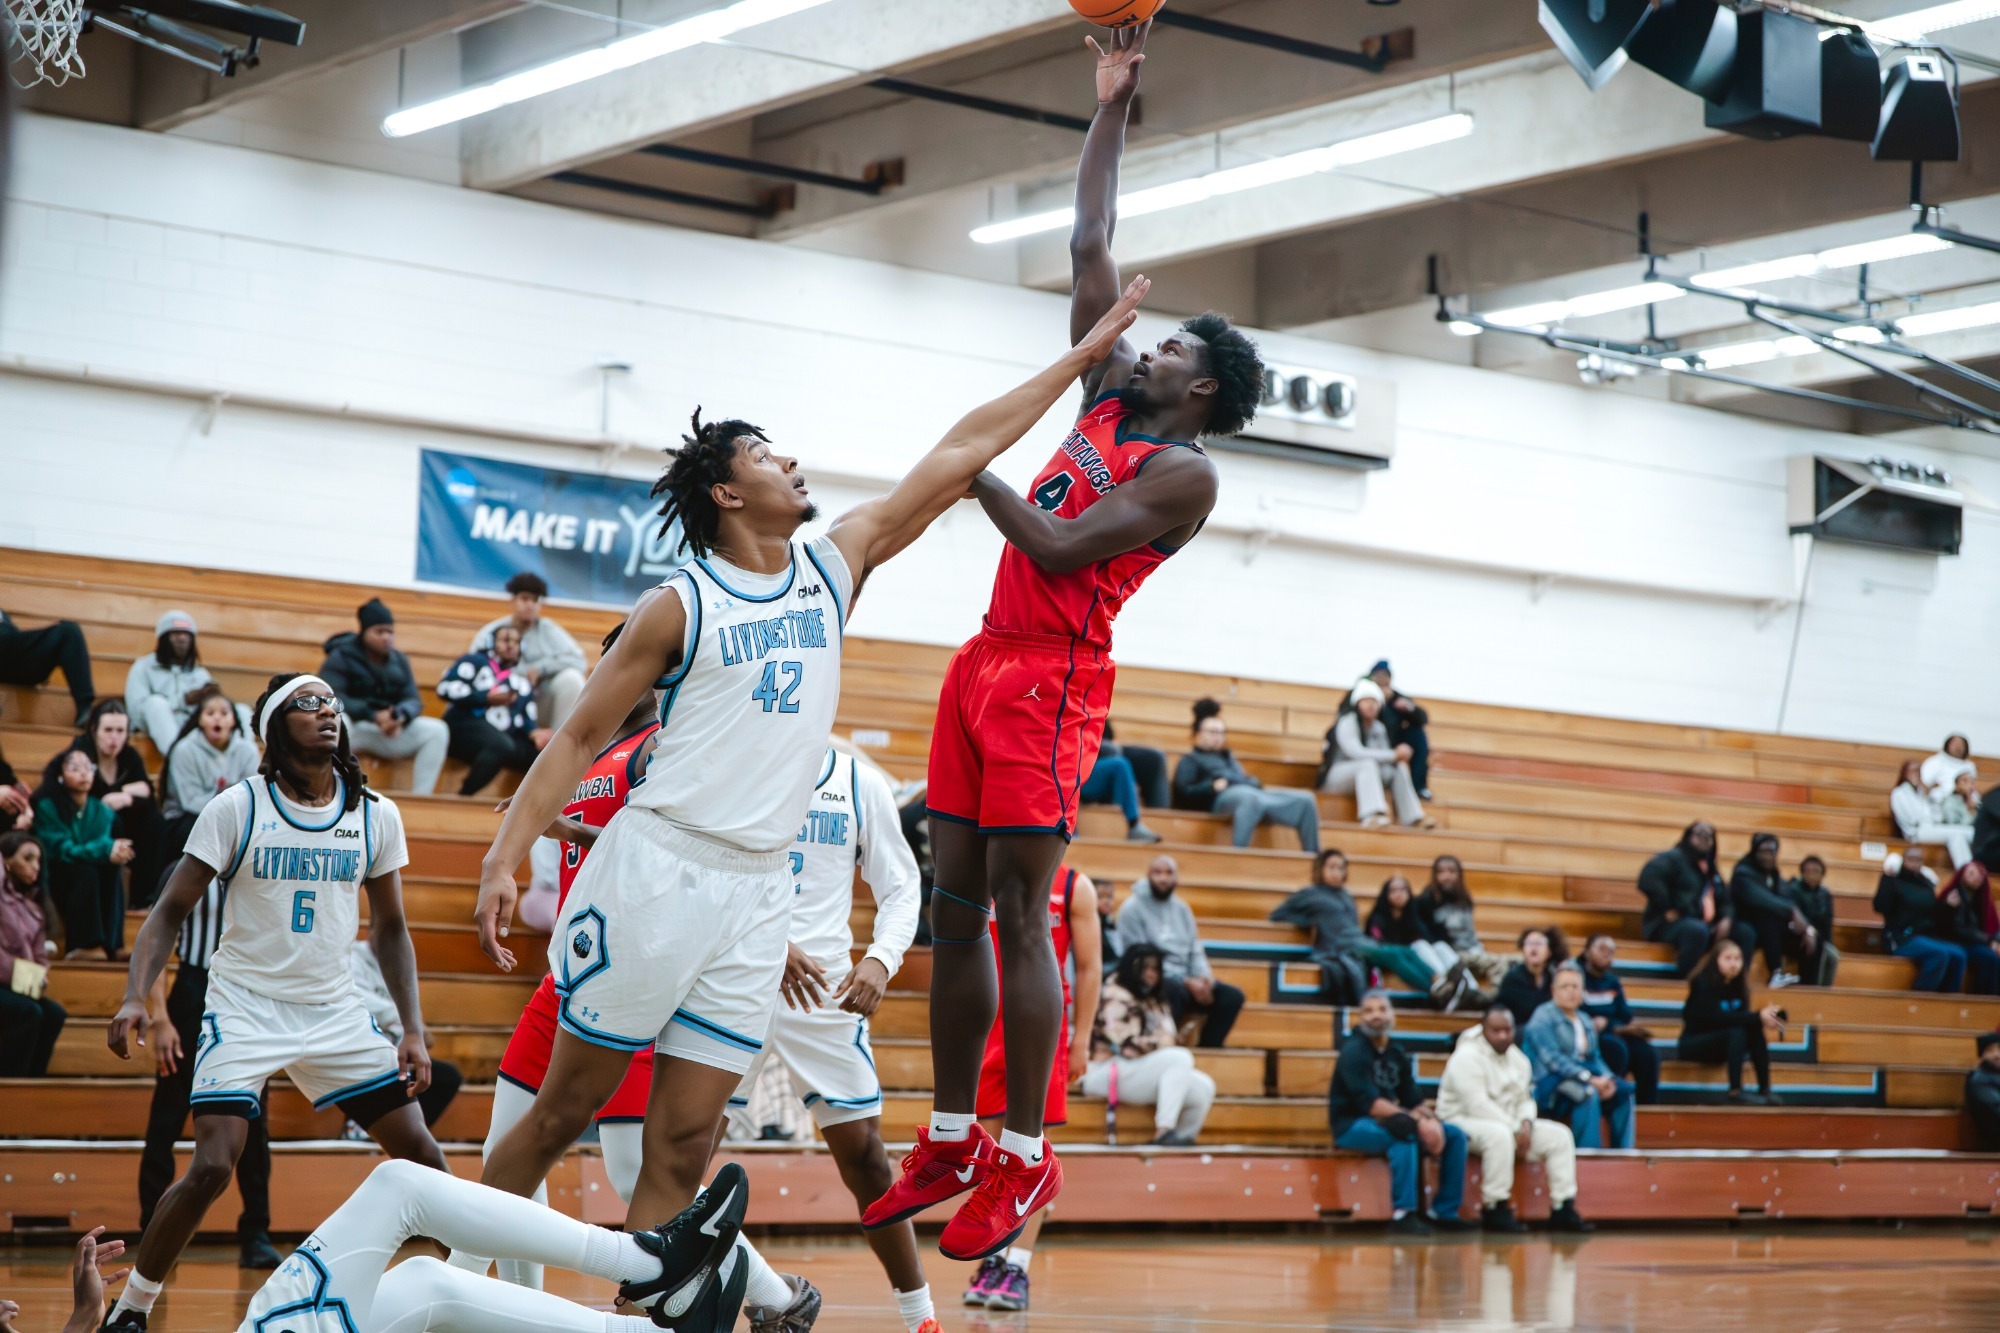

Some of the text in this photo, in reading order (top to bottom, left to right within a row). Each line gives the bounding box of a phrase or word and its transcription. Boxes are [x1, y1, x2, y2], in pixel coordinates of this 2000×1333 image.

[1034, 470, 1076, 513] 4
[470, 504, 579, 550] MAKE
[582, 518, 621, 555] IT
[718, 608, 827, 667] LIVINGSTONE
[752, 661, 803, 713] 42
[821, 791, 846, 803] CIAA
[334, 828, 360, 839] CIAA
[253, 847, 361, 882] LIVINGSTONE
[291, 890, 317, 934] 6
